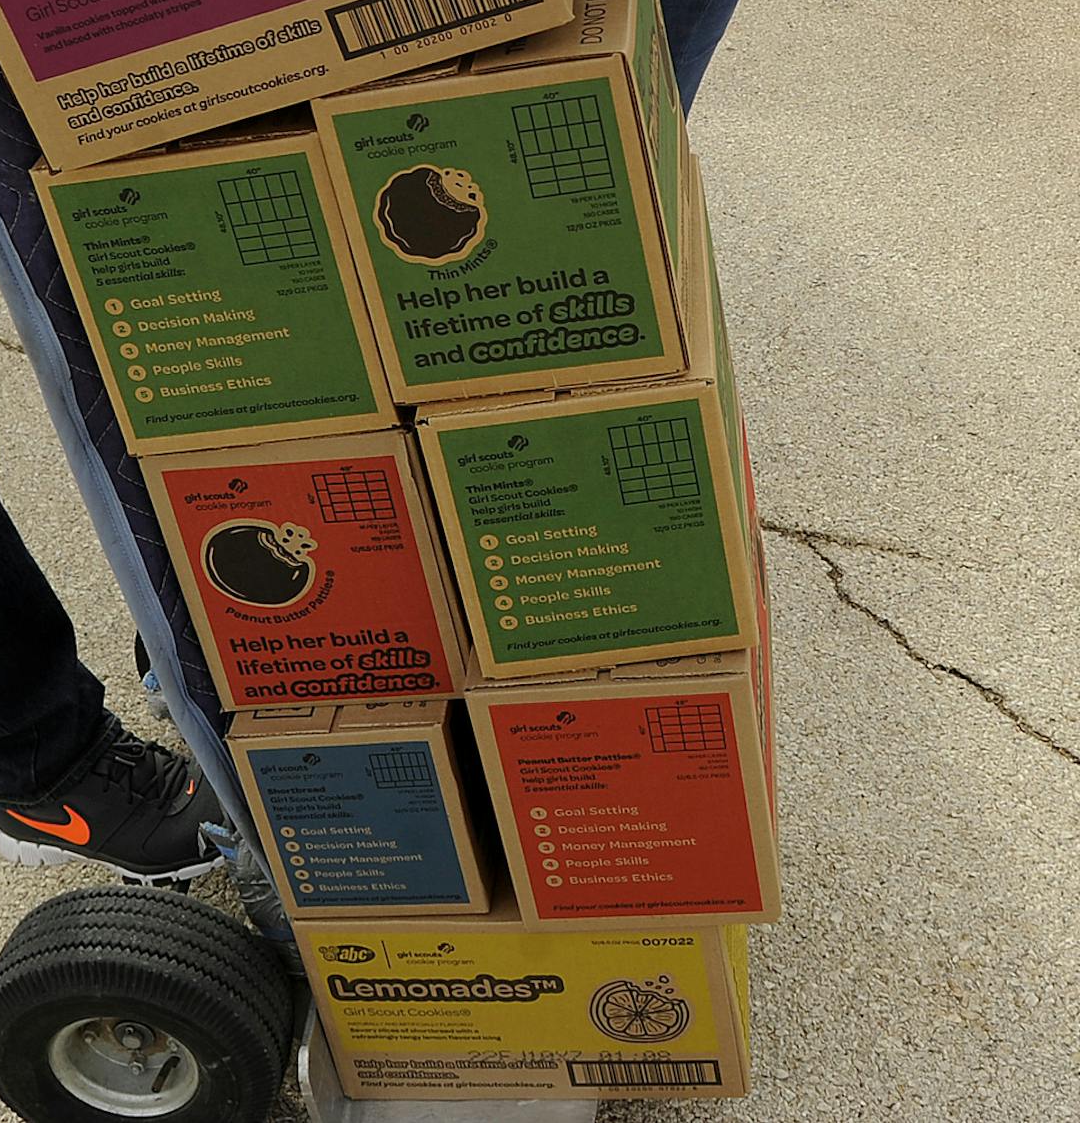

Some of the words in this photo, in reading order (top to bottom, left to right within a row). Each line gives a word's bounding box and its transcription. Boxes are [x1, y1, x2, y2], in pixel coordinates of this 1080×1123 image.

[25, 4, 55, 23] Girl
[36, 24, 71, 41] Vanilla
[71, 11, 111, 30] cookies
[111, 0, 147, 20] topped
[583, 3, 608, 26] NOT
[43, 40, 63, 54] and
[62, 31, 91, 50] laced
[91, 24, 115, 41] with
[416, 30, 454, 49] 20200
[459, 17, 498, 36] 07002
[580, 26, 604, 45] DO
[57, 88, 99, 110] Help
[97, 78, 129, 98] her
[128, 62, 175, 88] build
[175, 60, 189, 75] a
[187, 40, 255, 71] lifetime
[255, 30, 277, 51] of
[277, 19, 322, 44] skills
[68, 107, 102, 129] and
[101, 80, 200, 119] confidence.
[77, 128, 106, 146] Find
[105, 121, 134, 140] your
[136, 106, 182, 128] cookies
[183, 102, 198, 114] at
[199, 64, 330, 112] girlscoutcookies.org.
[354, 135, 374, 151] girl
[376, 131, 414, 145] scouts
[367, 146, 405, 159] cookie
[407, 139, 457, 157] program
[72, 208, 90, 222] girl
[92, 205, 128, 216] scouts
[84, 217, 119, 229] cookie
[122, 211, 168, 227] program
[83, 241, 110, 251] Thin
[88, 250, 108, 263] Girl
[110, 249, 141, 260] Scout
[428, 267, 460, 281] Thin
[130, 295, 164, 310] Goal
[167, 289, 222, 305] Setting
[397, 286, 461, 311] Help
[464, 281, 511, 302] her
[516, 268, 587, 296] build
[593, 270, 610, 285] a
[138, 315, 200, 332] Decision
[203, 308, 256, 322] Making
[404, 313, 511, 340] lifetime
[516, 303, 543, 325] of
[549, 291, 635, 323] skills
[145, 340, 192, 354] Money
[196, 327, 290, 347] Management
[152, 361, 202, 376] People
[205, 356, 243, 370] Skills
[414, 344, 465, 368] and
[159, 380, 224, 398] Business
[226, 375, 272, 389] Ethics
[145, 414, 168, 425] Find
[169, 412, 193, 423] your
[194, 404, 235, 418] cookies
[236, 405, 247, 414] at
[505, 531, 540, 545] Goal
[543, 525, 598, 541] Setting
[510, 549, 573, 566] Decision
[577, 542, 629, 557] Making
[515, 573, 563, 586] Money
[567, 559, 662, 579] Management
[520, 590, 570, 606] People
[573, 585, 612, 599] Skills
[225, 607, 272, 625] Peanut
[273, 607, 312, 624] Butter
[525, 609, 589, 626] Business
[592, 603, 638, 617] Ethics
[229, 635, 284, 654] Help
[286, 634, 327, 650] her
[329, 628, 390, 647] build
[394, 630, 409, 643] a
[237, 656, 327, 676] lifetime
[330, 654, 355, 670] of
[358, 647, 431, 671] skills
[244, 681, 287, 698] and
[554, 807, 586, 817] Goal
[589, 805, 639, 816] Setting
[300, 827, 327, 836] Goal
[330, 826, 372, 836] Setting
[558, 824, 616, 835] Decision
[619, 821, 668, 832] Making
[304, 841, 354, 850] Decision
[356, 840, 398, 849] Making
[561, 842, 606, 852] Money
[609, 837, 697, 849] Management
[309, 856, 347, 865] Money
[349, 853, 423, 863] Management
[565, 857, 612, 869] People
[615, 856, 650, 867] Skills
[314, 869, 353, 879] People
[356, 868, 385, 877] Skills
[569, 875, 628, 885] Business
[631, 873, 674, 883] Ethics
[319, 884, 369, 892] Business
[371, 883, 407, 891] Ethics
[642, 937, 694, 946] 007022
[344, 1008, 366, 1017] Girl
[367, 1008, 405, 1017] Scout
